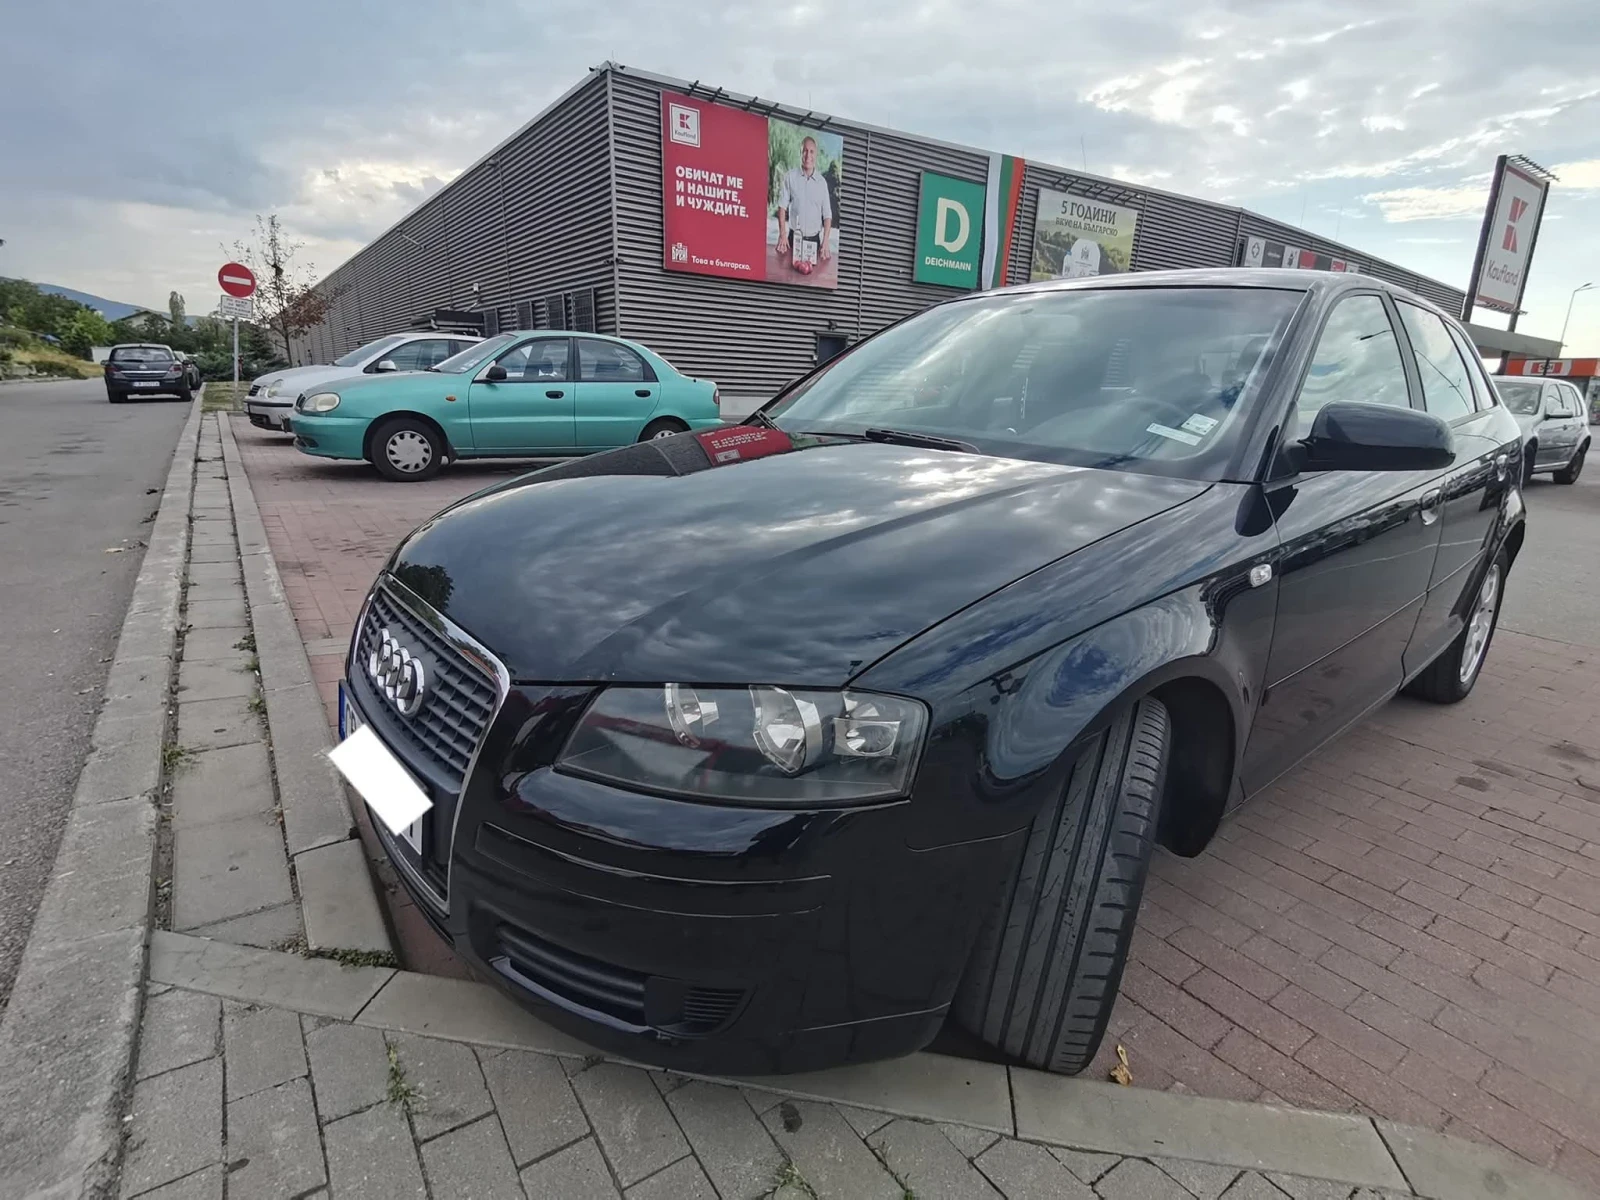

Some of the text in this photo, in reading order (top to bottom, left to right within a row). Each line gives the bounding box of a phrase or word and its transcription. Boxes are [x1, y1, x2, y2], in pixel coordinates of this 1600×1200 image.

[674, 128, 697, 141] Kaufland
[675, 165, 744, 189] ОБИЧАТ МЕ
[675, 180, 742, 204] И НАШИТЕ,
[676, 194, 749, 218] И ЧУЖДИТЕ.
[1061, 200, 1117, 226] 5 ГОДИНИ
[1073, 221, 1083, 230] НА
[1083, 222, 1119, 238] БЪЛГАРСКО
[691, 255, 709, 265] Това
[924, 256, 972, 271] DEICHMANN
[1486, 259, 1521, 287] Kaufland
